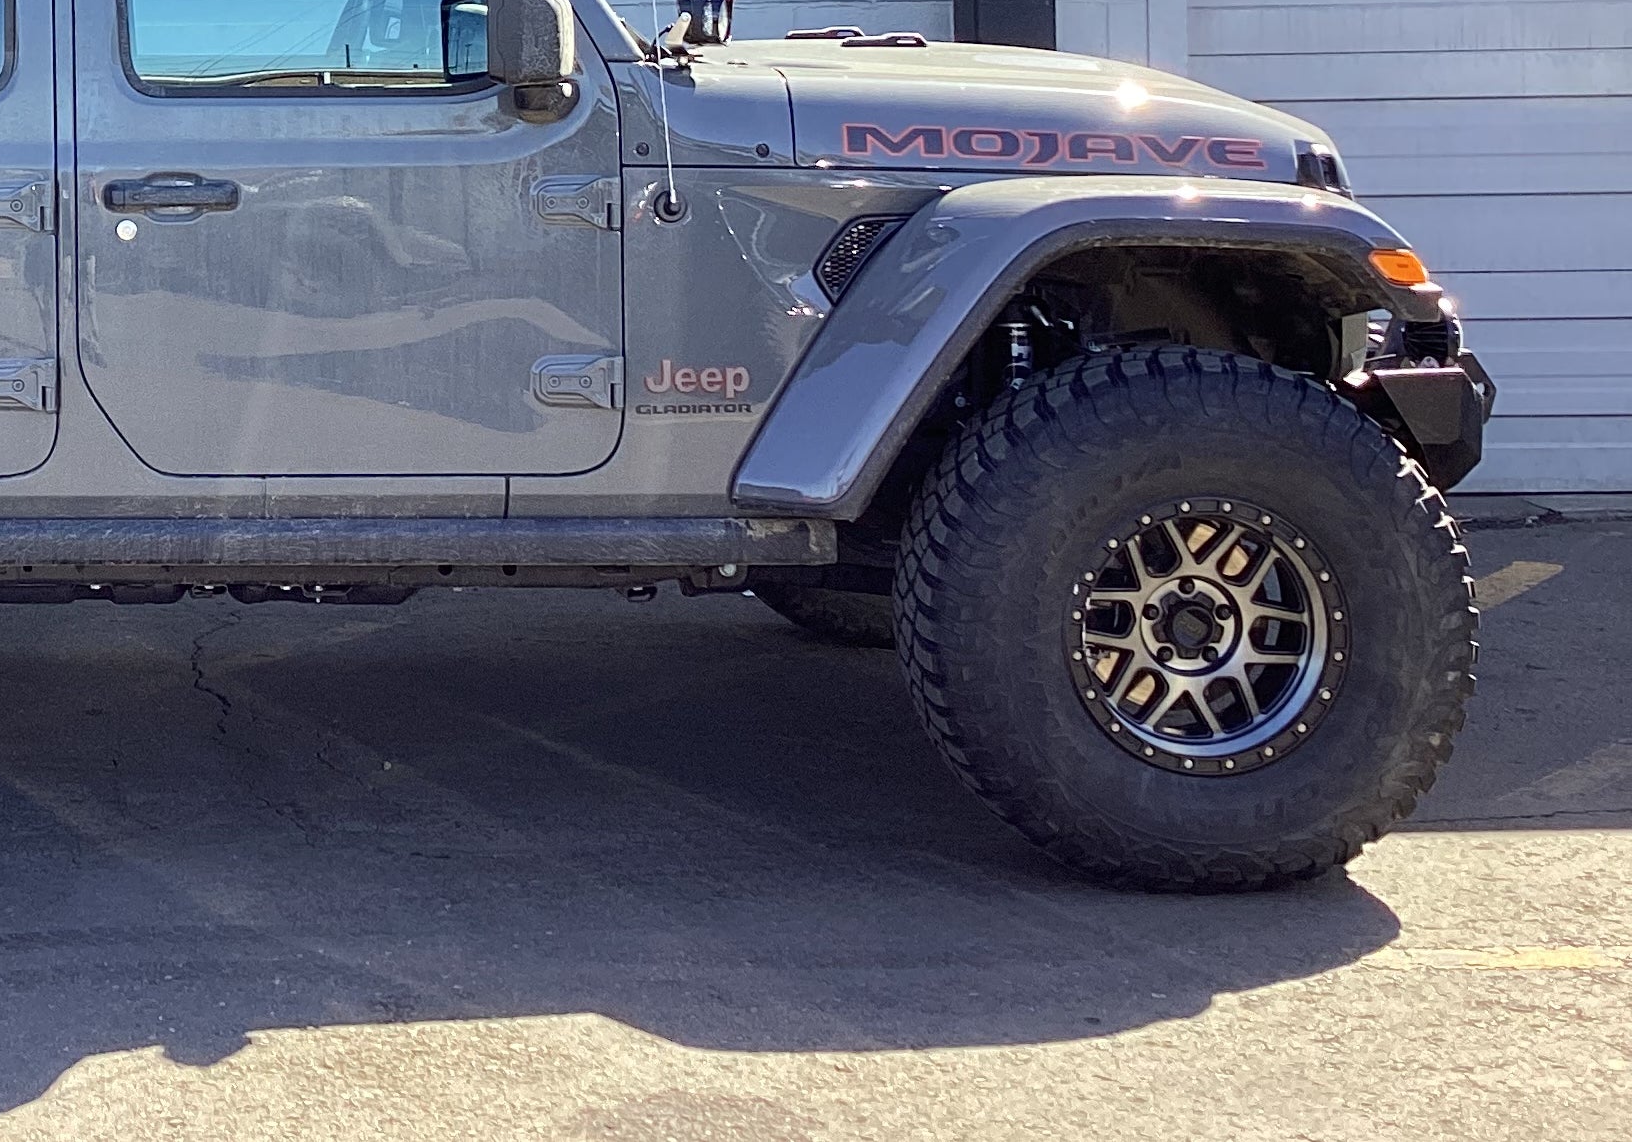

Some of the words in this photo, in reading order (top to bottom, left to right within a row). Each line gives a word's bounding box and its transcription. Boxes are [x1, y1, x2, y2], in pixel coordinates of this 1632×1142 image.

[842, 123, 1265, 167] MOJAVE
[644, 359, 750, 399] Jeep
[635, 403, 752, 415] GLADIATOR
